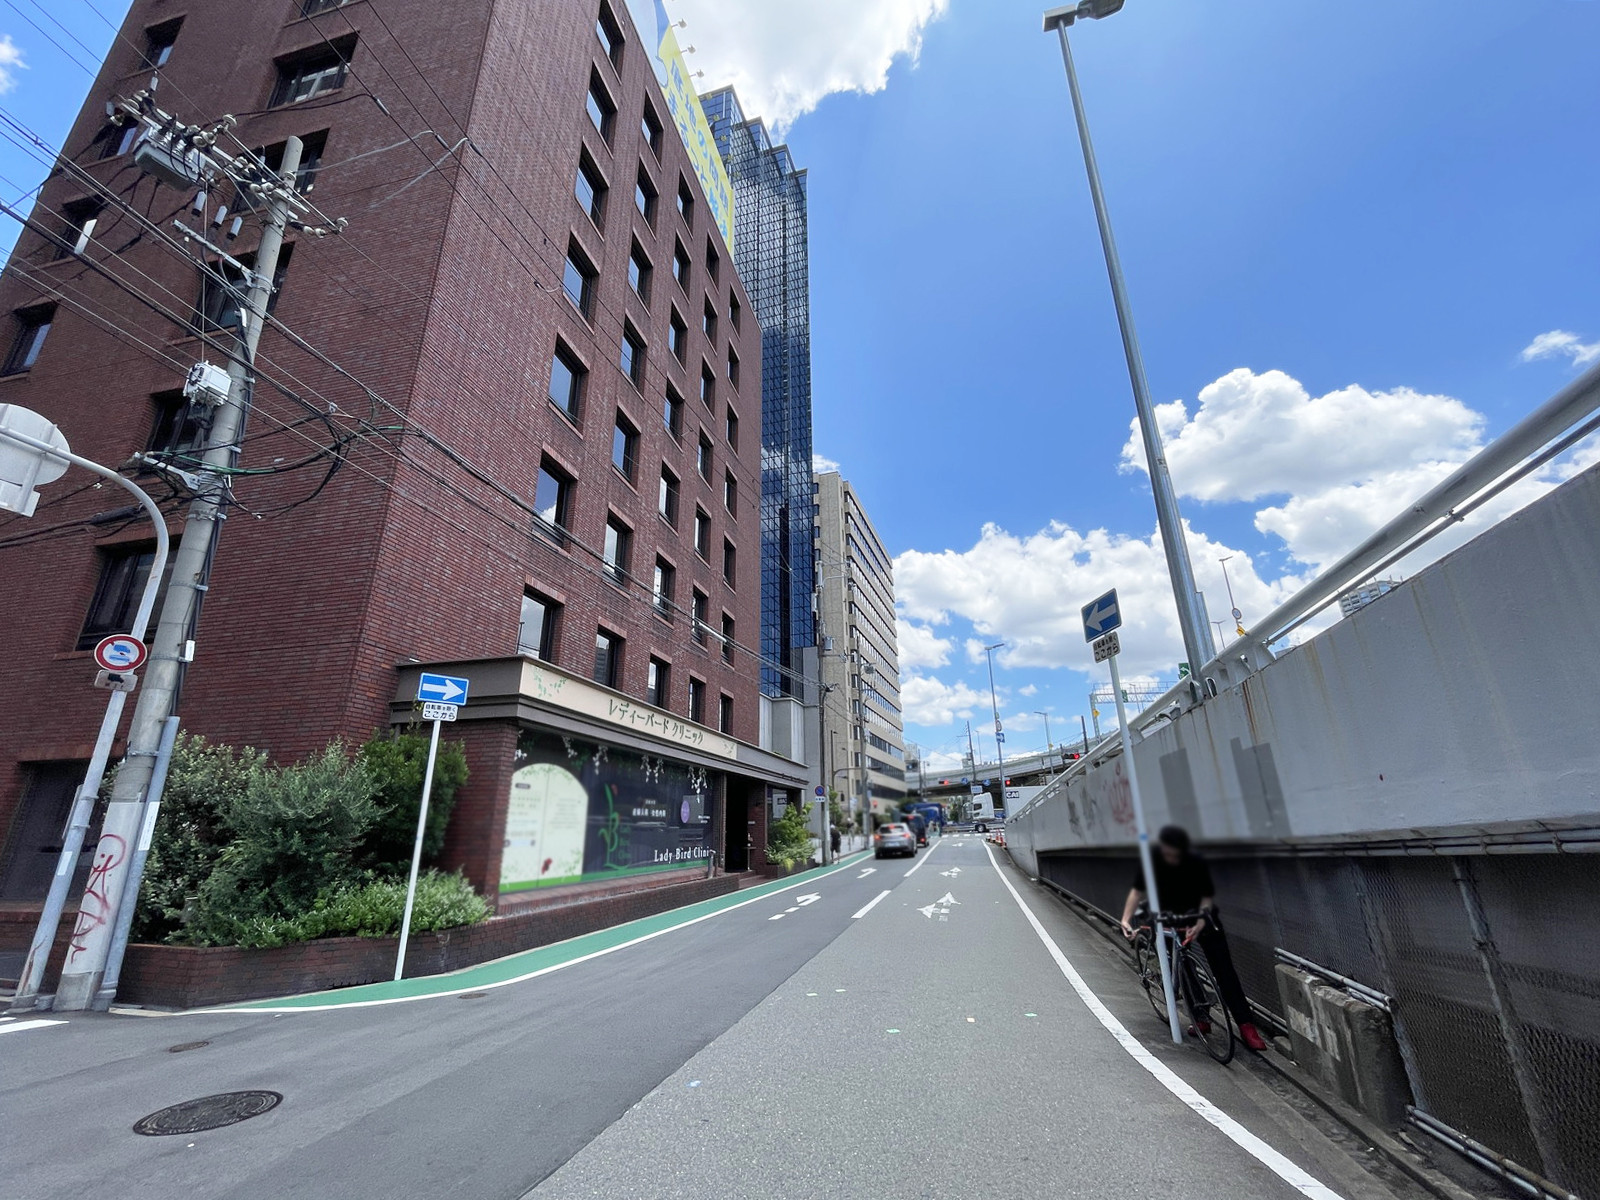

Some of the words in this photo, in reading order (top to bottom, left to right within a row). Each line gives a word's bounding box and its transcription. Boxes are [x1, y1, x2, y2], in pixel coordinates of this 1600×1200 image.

[1095, 643, 1119, 660] ここから
[424, 710, 455, 719] ここから
[672, 722, 704, 745] クリニック
[654, 848, 673, 864] Lady
[675, 846, 692, 860] Bird
[693, 845, 711, 859] Clini
